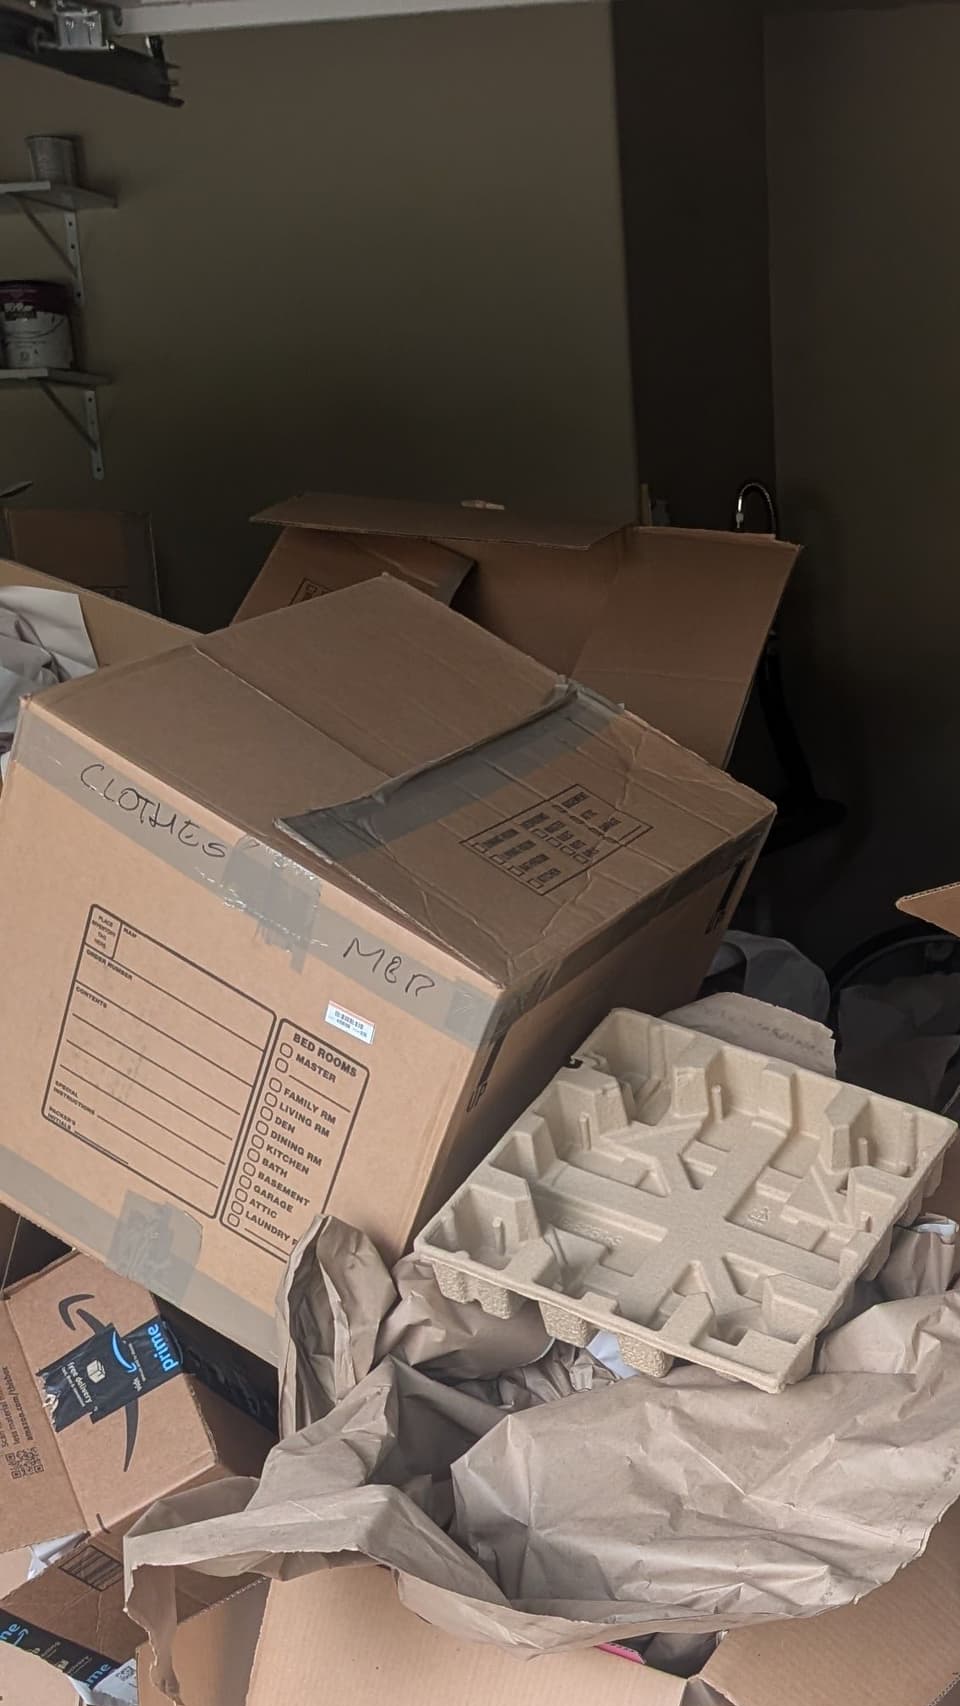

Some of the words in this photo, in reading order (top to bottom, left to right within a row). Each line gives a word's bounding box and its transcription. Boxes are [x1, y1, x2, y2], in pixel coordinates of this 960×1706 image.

[80, 763, 226, 858] CLOTHES
[75, 986, 108, 1009] CONTENTS
[292, 1032, 316, 1053] BED
[317, 1047, 358, 1078] ROOMS
[295, 1053, 337, 1084] MASTER
[55, 1080, 79, 1099] SPECIAL
[278, 1101, 313, 1128] LIVING
[314, 1123, 331, 1138] RM
[283, 1087, 320, 1114] FAMILY
[320, 1109, 337, 1125] RM
[274, 1116, 296, 1134] DEN
[265, 1144, 310, 1176] KITCHEN
[270, 1130, 305, 1157] DINING
[306, 1151, 323, 1167] RM
[261, 1157, 289, 1179] BATH
[253, 1184, 295, 1214] GARAGE
[257, 1171, 311, 1207] BASEMENT
[248, 1198, 278, 1219] ATTIC
[244, 1210, 291, 1245] LAUNDRY
[147, 1323, 179, 1372] prime
[75, 1375, 94, 1404] delivery
